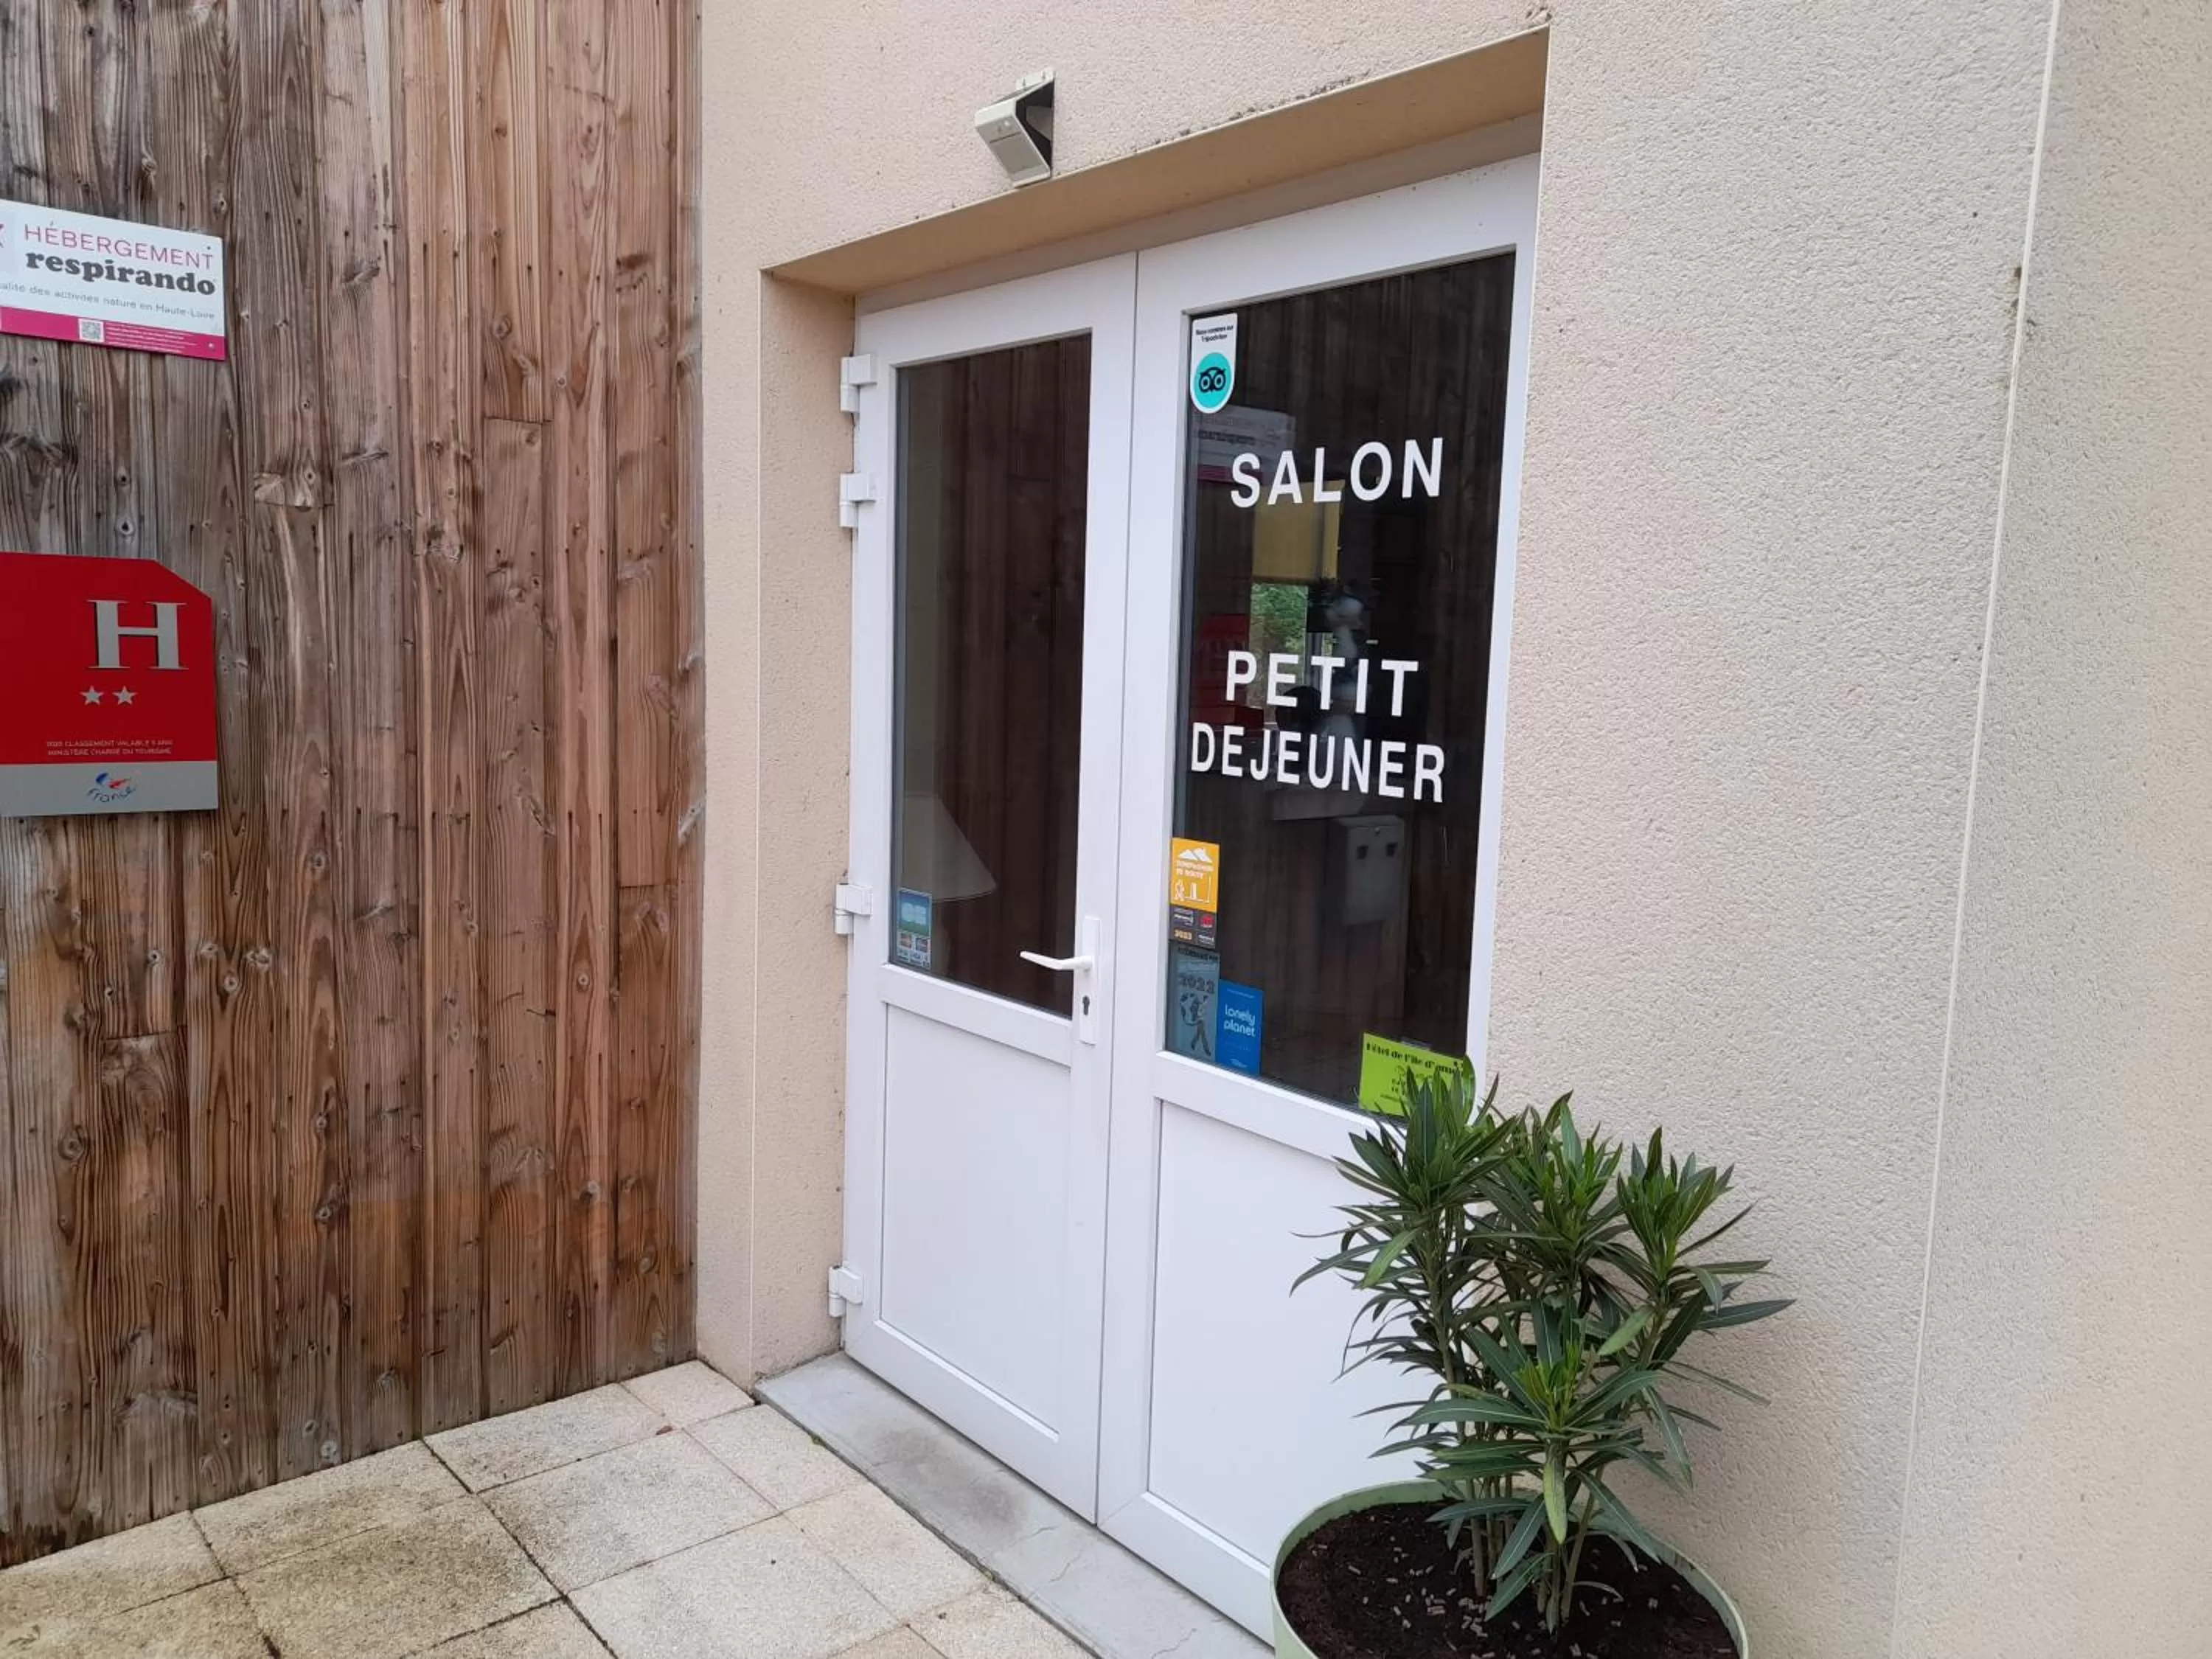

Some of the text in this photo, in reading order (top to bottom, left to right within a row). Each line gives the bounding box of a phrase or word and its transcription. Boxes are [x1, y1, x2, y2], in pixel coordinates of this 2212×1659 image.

[24, 221, 213, 270] HÉBERGEMENT
[26, 252, 215, 295] respirando
[103, 297, 136, 309] nature
[1231, 437, 1443, 509] SALON
[86, 599, 189, 670] H
[1225, 650, 1419, 717] PETIT
[1191, 721, 1445, 803] DEJEUNER
[1223, 1019, 1256, 1037] planet
[1225, 1004, 1256, 1027] lonely
